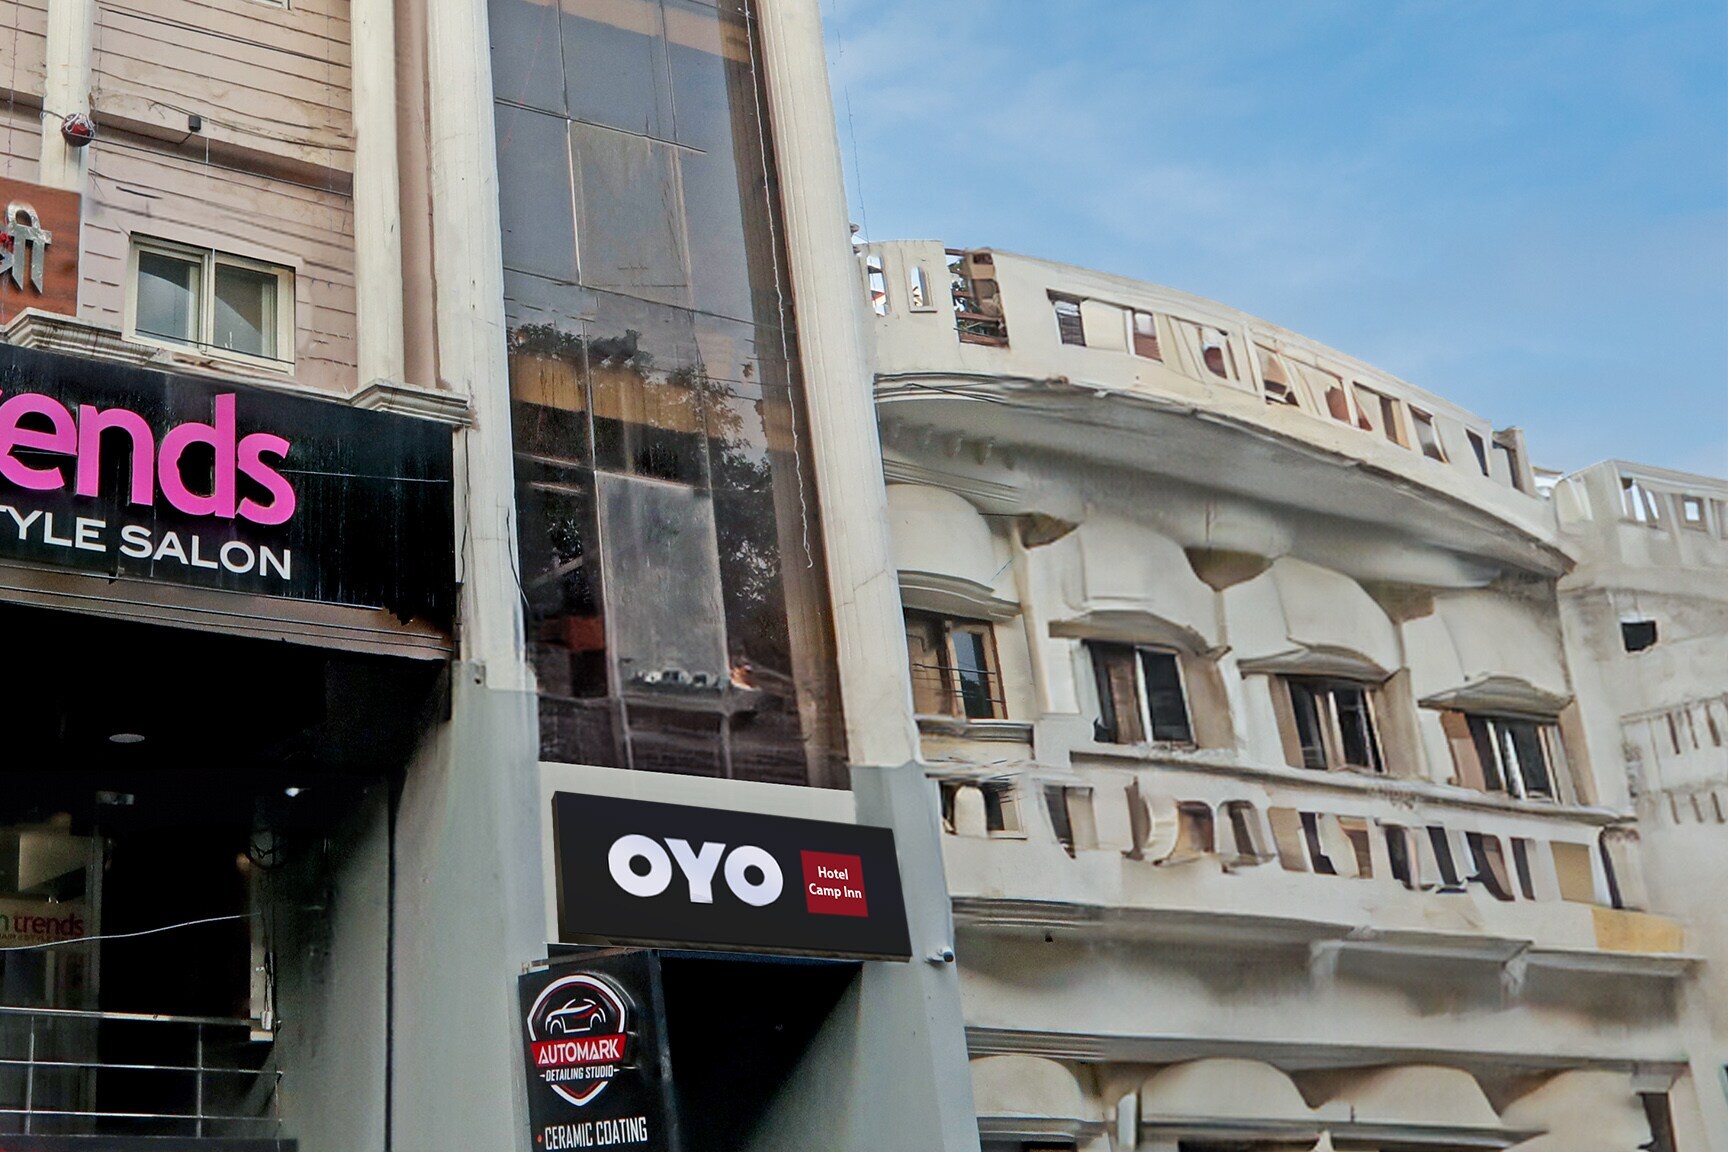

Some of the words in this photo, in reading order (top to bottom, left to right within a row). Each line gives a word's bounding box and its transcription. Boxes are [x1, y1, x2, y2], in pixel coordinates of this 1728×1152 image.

[120, 524, 292, 580] SALON
[608, 834, 784, 906] OYO
[818, 866, 849, 881] Hotel
[809, 883, 841, 900] Camp
[844, 885, 862, 899] Inn
[13, 914, 84, 936] trends
[538, 1038, 620, 1064] AUTOMARK
[546, 1067, 583, 1082] DETAILING
[585, 1065, 614, 1079] STUDIO
[545, 1122, 593, 1150] CERAMIC
[596, 1116, 648, 1145] COATING
